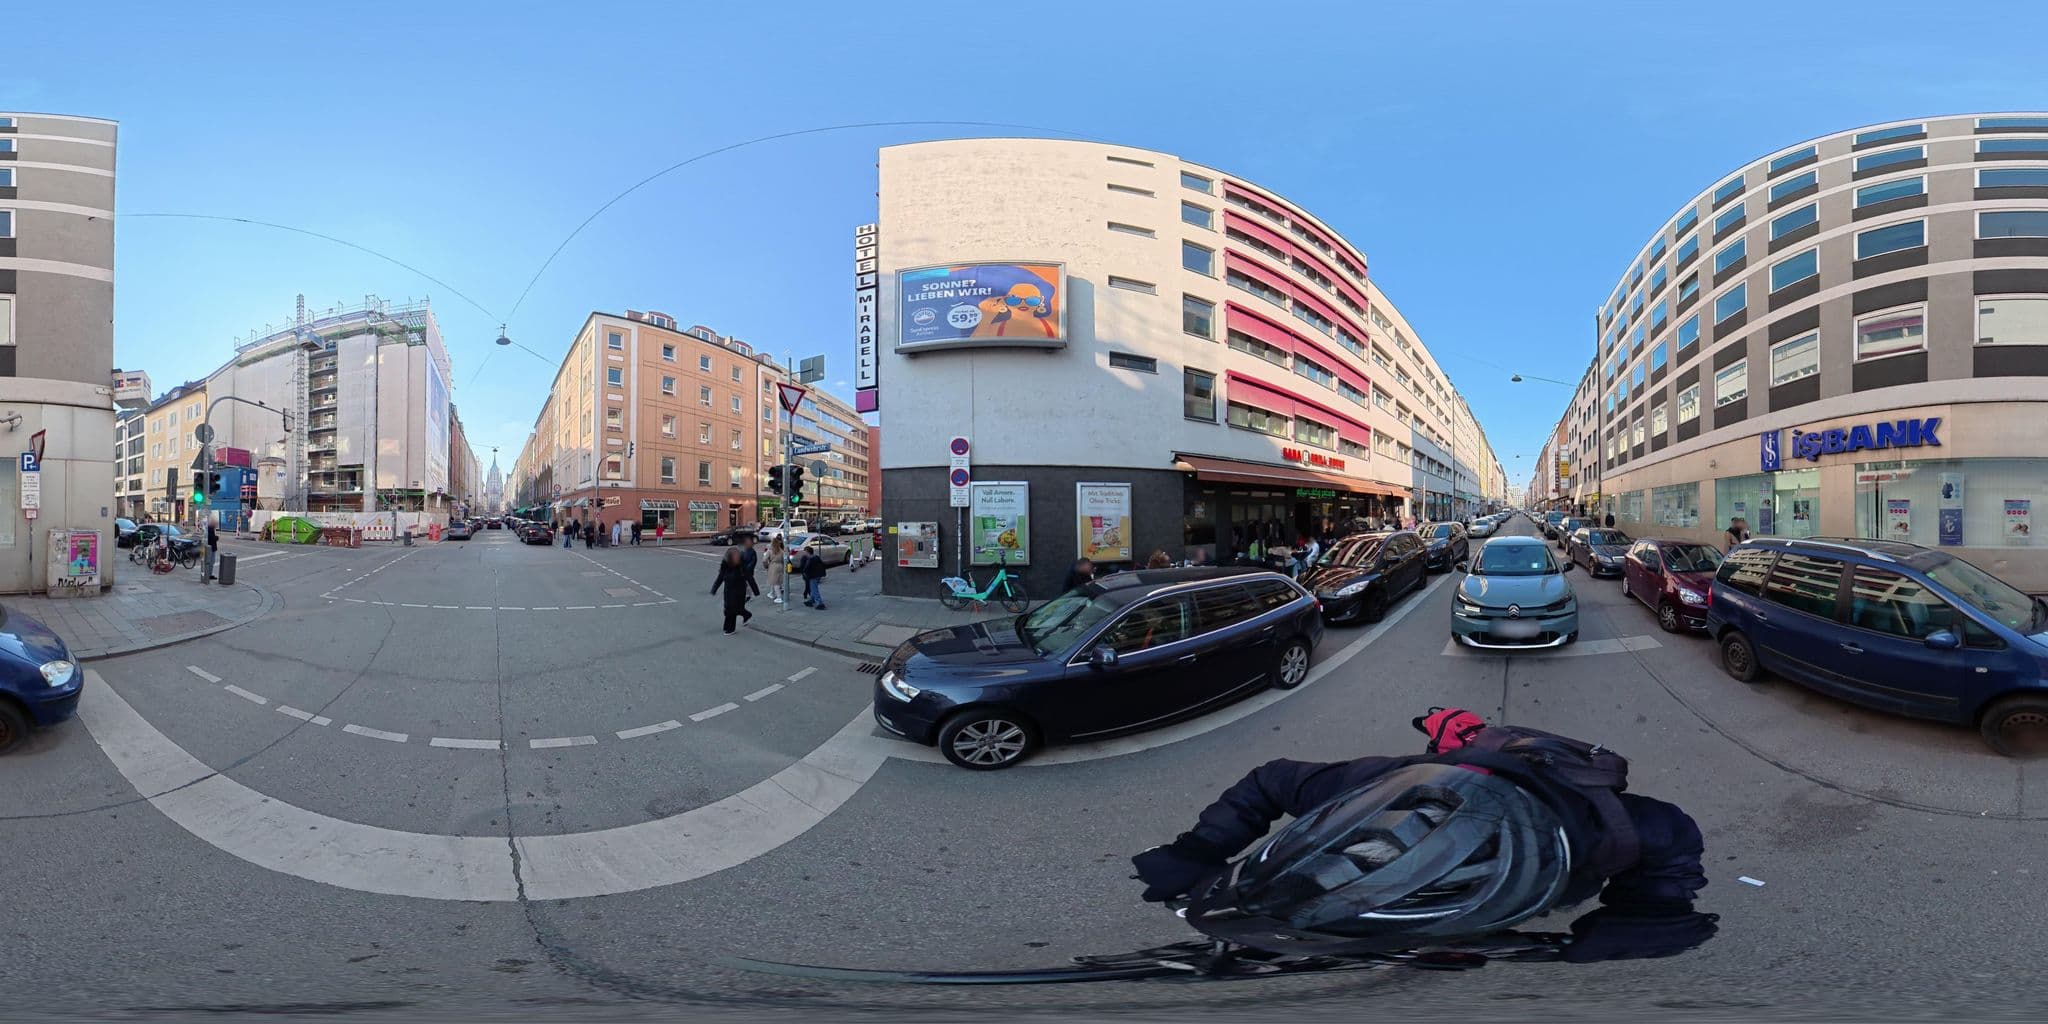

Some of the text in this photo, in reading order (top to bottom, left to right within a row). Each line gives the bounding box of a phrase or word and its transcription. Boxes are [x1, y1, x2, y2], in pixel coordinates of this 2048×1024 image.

[922, 280, 976, 291] SONNE?
[859, 225, 872, 380] HOTEL MIRABELL
[908, 288, 992, 302] LIEBEN WIR!
[23, 454, 35, 470] P
